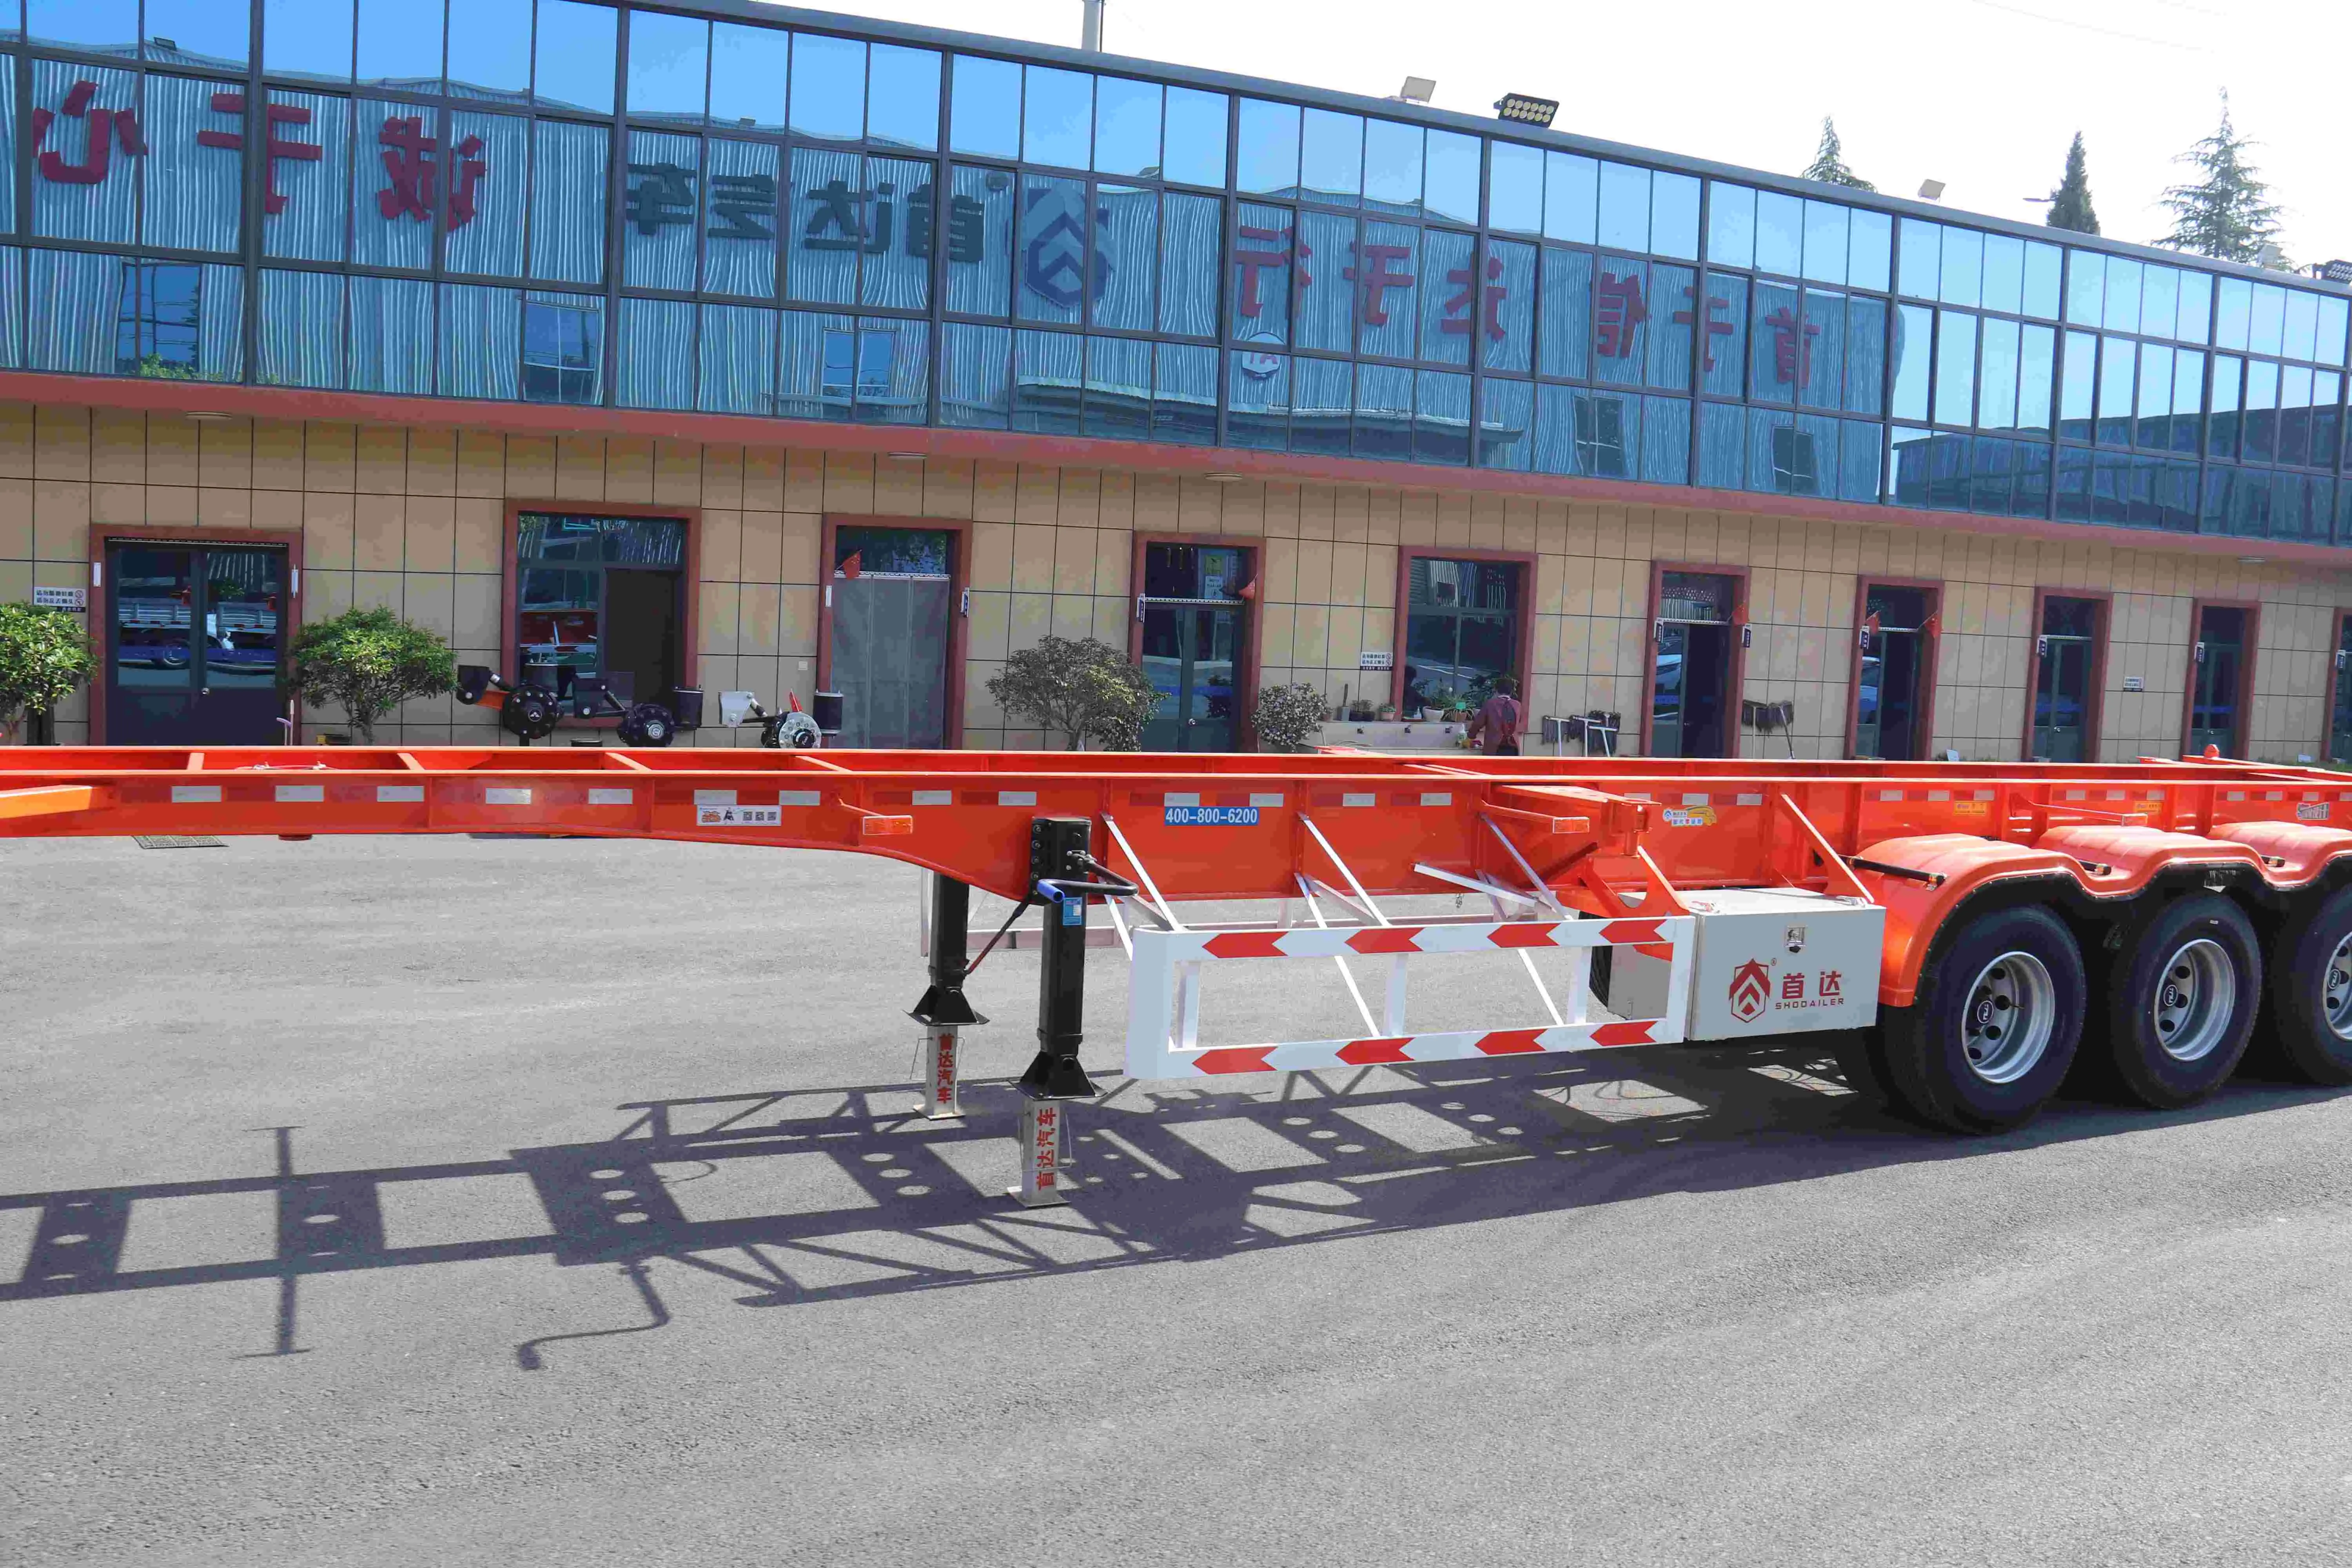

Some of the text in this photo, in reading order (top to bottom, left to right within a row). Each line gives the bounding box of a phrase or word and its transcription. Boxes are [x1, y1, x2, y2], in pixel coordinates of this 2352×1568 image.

[1165, 808, 1258, 823] 400-800-6200
[1782, 971, 1842, 999] 首达
[1775, 998, 1844, 1009] SHODAILER
[937, 1033, 955, 1104] 首达汽车
[1036, 1107, 1056, 1191] 首达汽车
